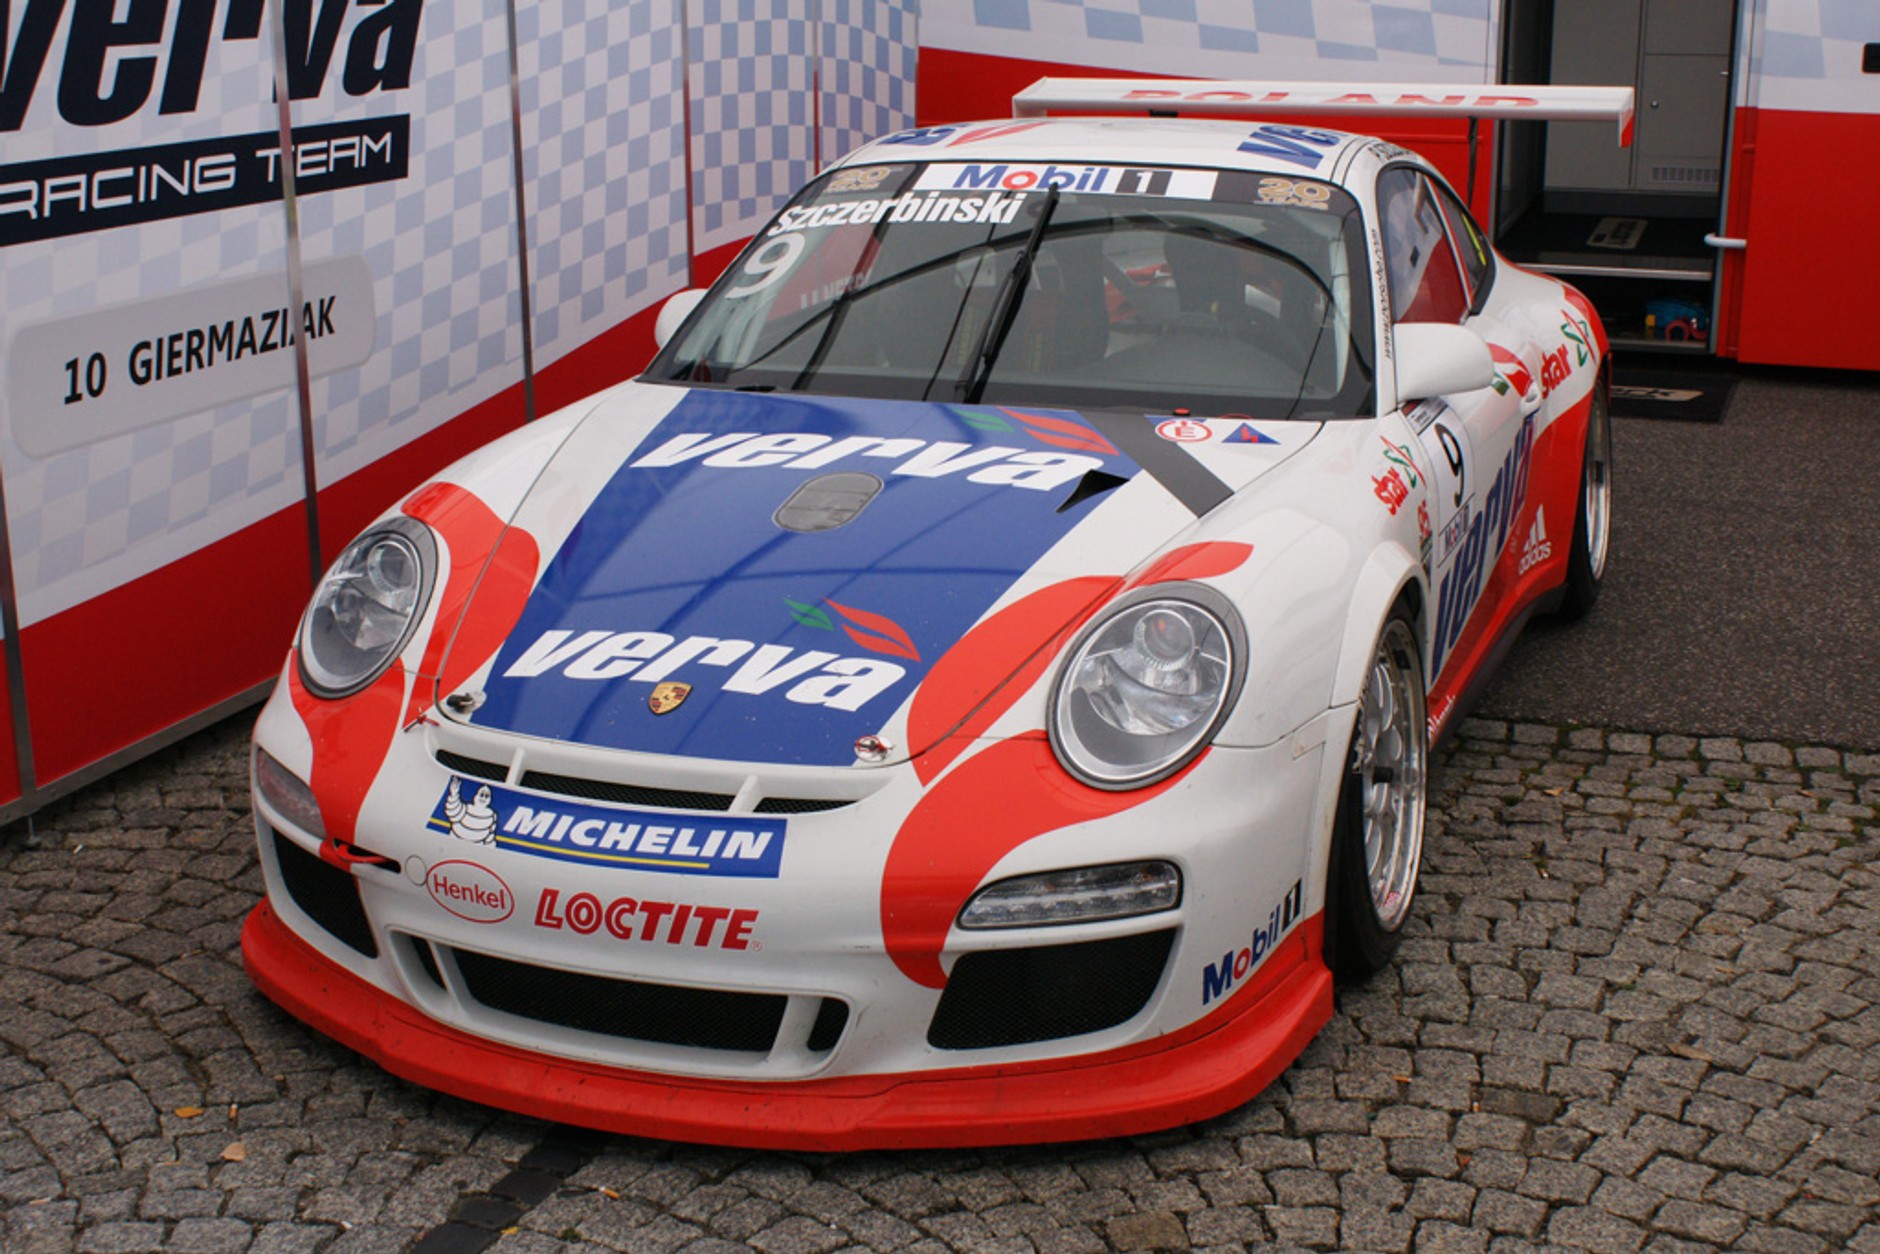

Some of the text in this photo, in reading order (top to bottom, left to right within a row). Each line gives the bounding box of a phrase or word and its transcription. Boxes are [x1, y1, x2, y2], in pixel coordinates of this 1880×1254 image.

[1119, 88, 1539, 107] POLAND
[0, 131, 392, 220] RACING TEAM
[952, 164, 1108, 192] Mobil
[1258, 178, 1330, 201] 20
[767, 191, 1028, 236] Szczerbinski
[724, 231, 806, 300] 9
[64, 352, 108, 405] 10
[1541, 343, 1572, 399] star
[628, 432, 1105, 492] verva
[1434, 422, 1465, 508] 9
[1371, 466, 1409, 516] star
[1431, 408, 1538, 684] verva
[1519, 540, 1552, 576] adidas
[502, 629, 907, 713] verva
[503, 805, 774, 860] MICHELIN
[433, 874, 506, 910] Henkel
[1202, 903, 1281, 1006] Mobil
